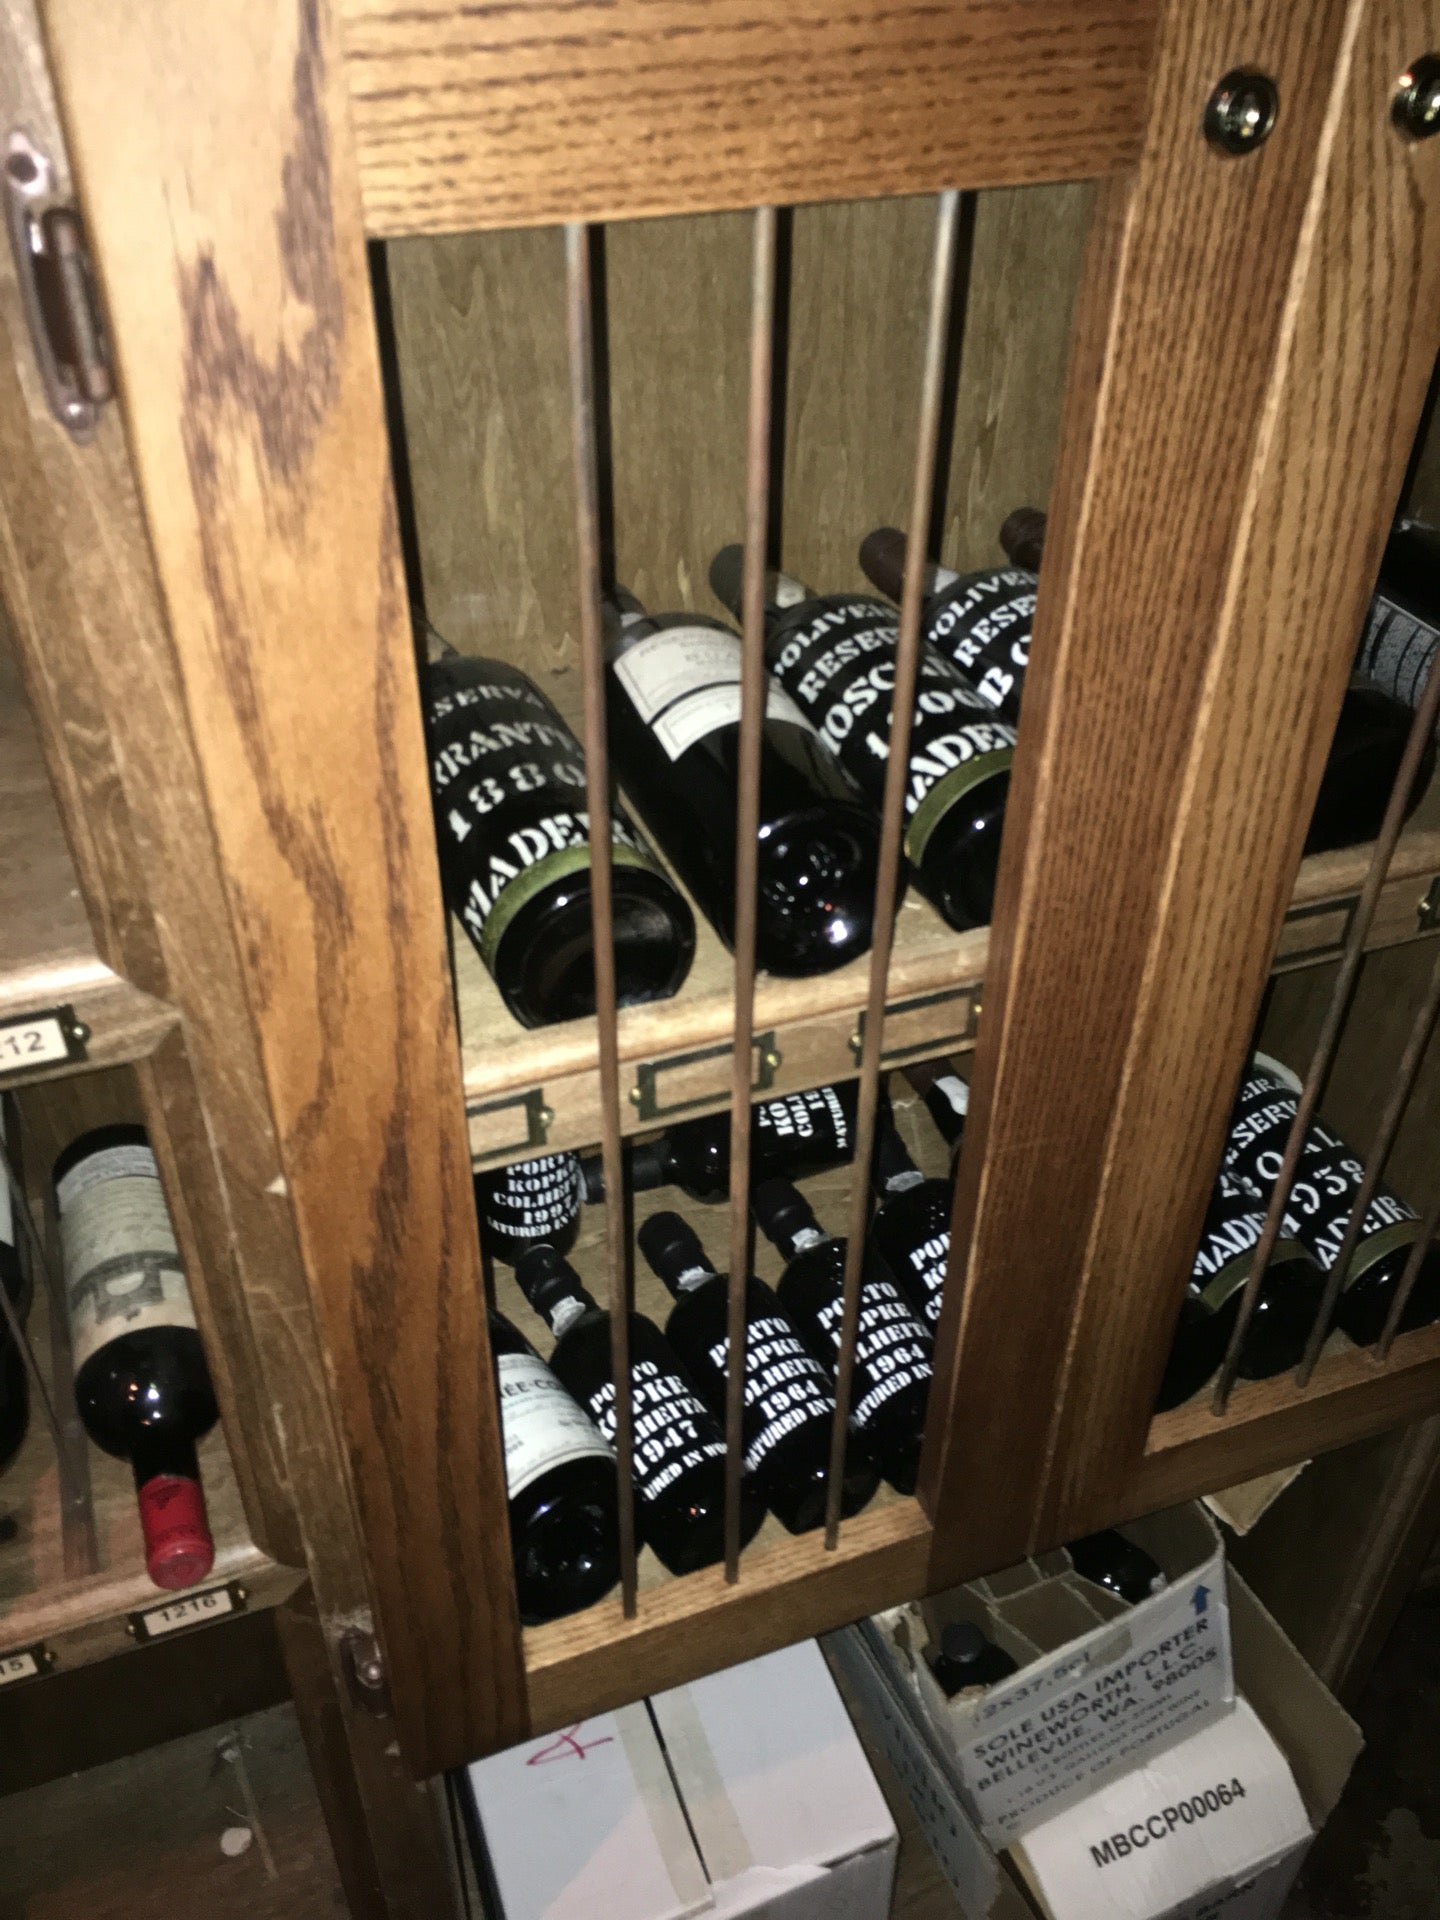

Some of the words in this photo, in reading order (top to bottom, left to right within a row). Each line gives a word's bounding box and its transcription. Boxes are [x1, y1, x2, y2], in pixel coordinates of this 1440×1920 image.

[816, 1282, 899, 1330] POTO
[589, 1361, 659, 1414] POTO
[865, 1343, 925, 1382] 1964
[760, 1379, 821, 1420] 1964
[633, 1419, 699, 1476] 1947
[974, 1718, 1032, 1759] SOLE
[1041, 1691, 1089, 1723] USA
[1095, 1617, 1208, 1692] IMPORTER
[1090, 1777, 1246, 1868] MBCCP00064
